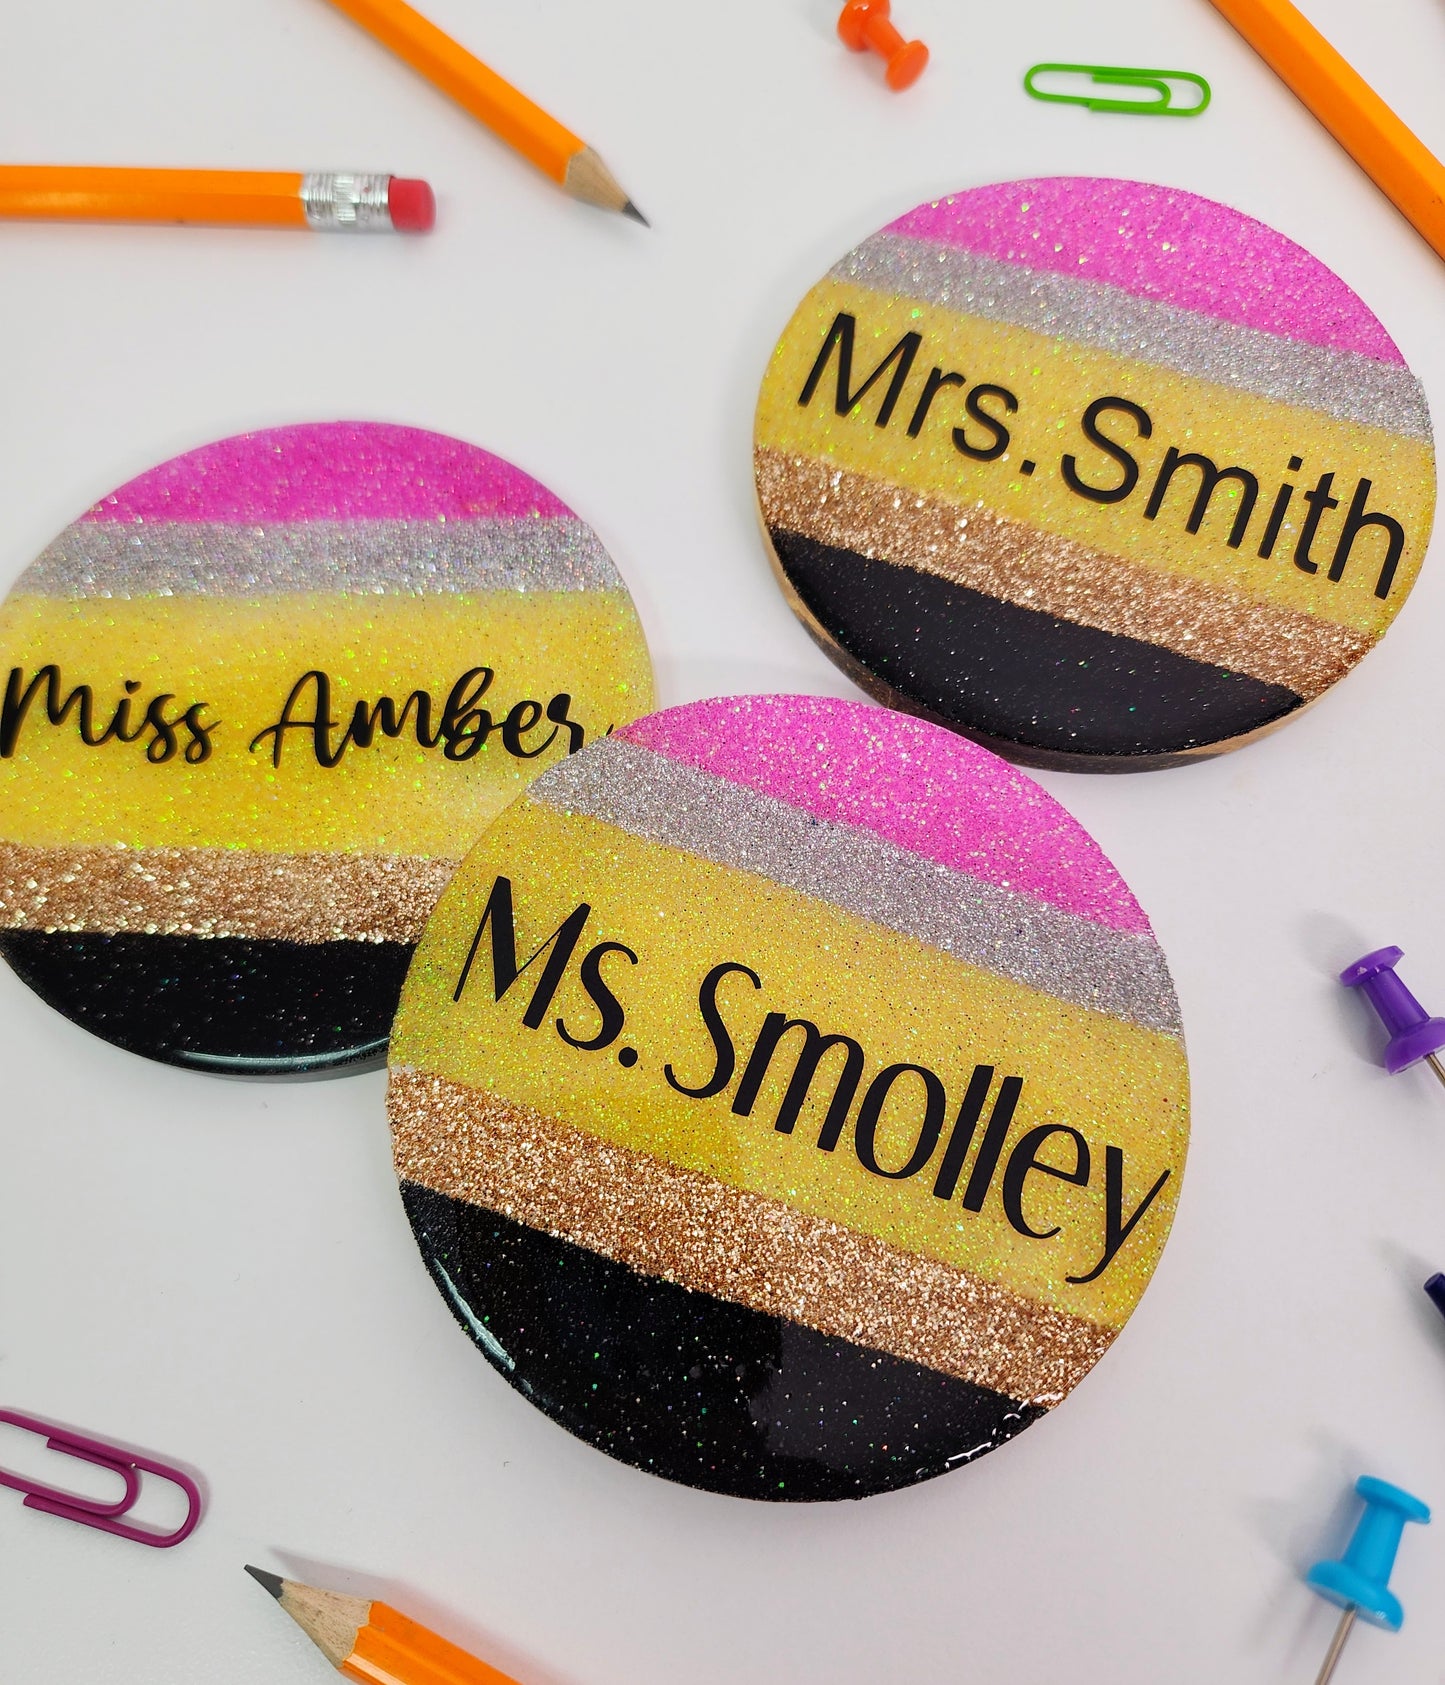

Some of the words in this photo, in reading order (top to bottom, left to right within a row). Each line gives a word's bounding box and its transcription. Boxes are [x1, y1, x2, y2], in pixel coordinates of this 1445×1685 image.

[0, 664, 222, 765] Miss
[248, 665, 614, 769] Amber
[452, 874, 640, 1069] Ms.
[663, 961, 1172, 1285] Smolley
